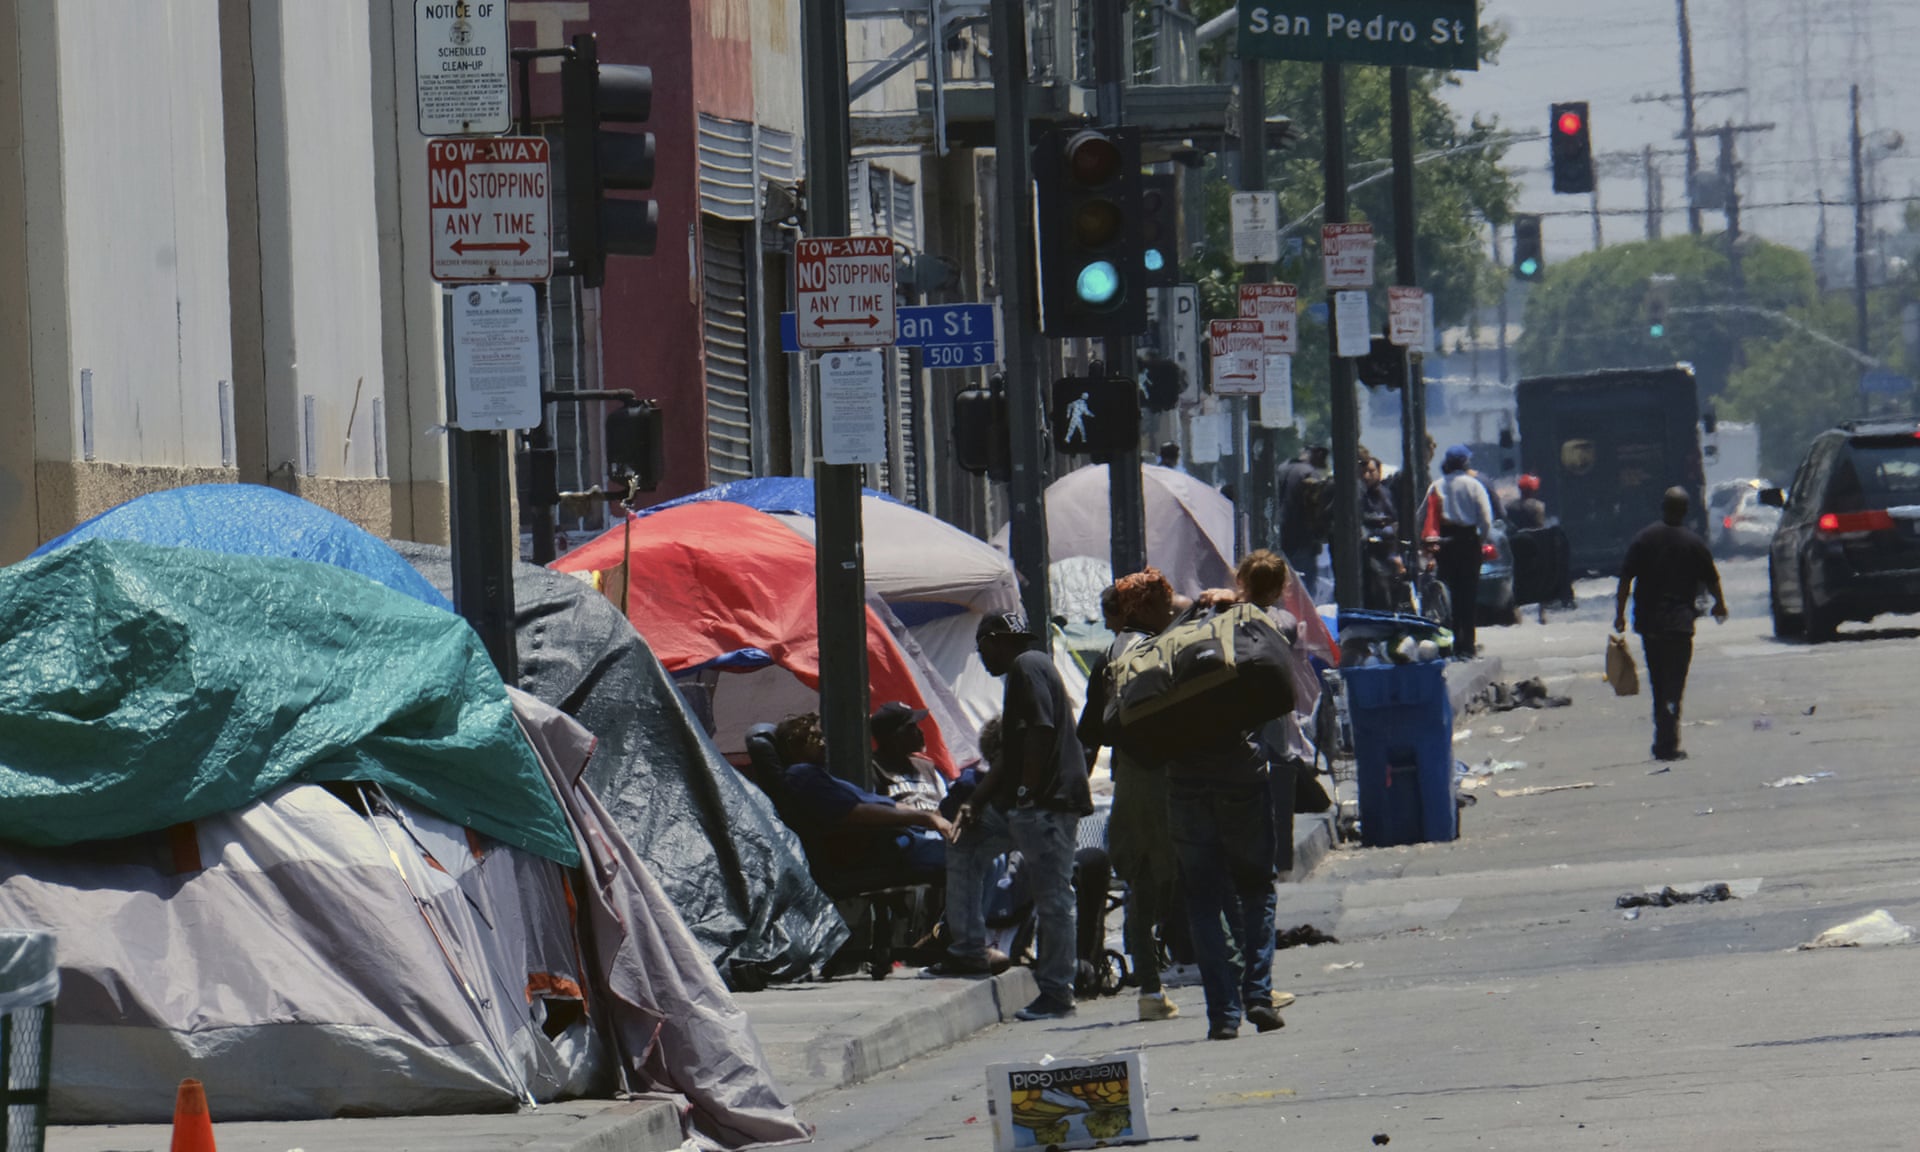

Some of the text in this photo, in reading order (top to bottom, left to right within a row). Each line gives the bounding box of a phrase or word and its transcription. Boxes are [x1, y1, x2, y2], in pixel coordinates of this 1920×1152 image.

[426, 4, 494, 19] NOTICE OF
[1249, 7, 1464, 45] San Pedro St
[438, 46, 486, 57] SCHEDULED
[442, 61, 483, 71] CLEAN-UP
[432, 142, 544, 161] TOW-AWAY
[432, 168, 545, 205] NO STOPPING
[445, 213, 535, 235] ANY TIME
[799, 240, 889, 256] TOW-AWAY
[798, 261, 890, 289] NO STOPPING
[810, 294, 883, 312] ANY TIME
[1241, 299, 1256, 318] NO
[896, 312, 972, 338] ian St
[1270, 320, 1289, 331] TIME
[1213, 336, 1263, 355] NO STOPPING
[931, 347, 983, 365] 500 S
[1239, 358, 1259, 371] TIME
[1013, 1063, 1127, 1090] Western Gold
